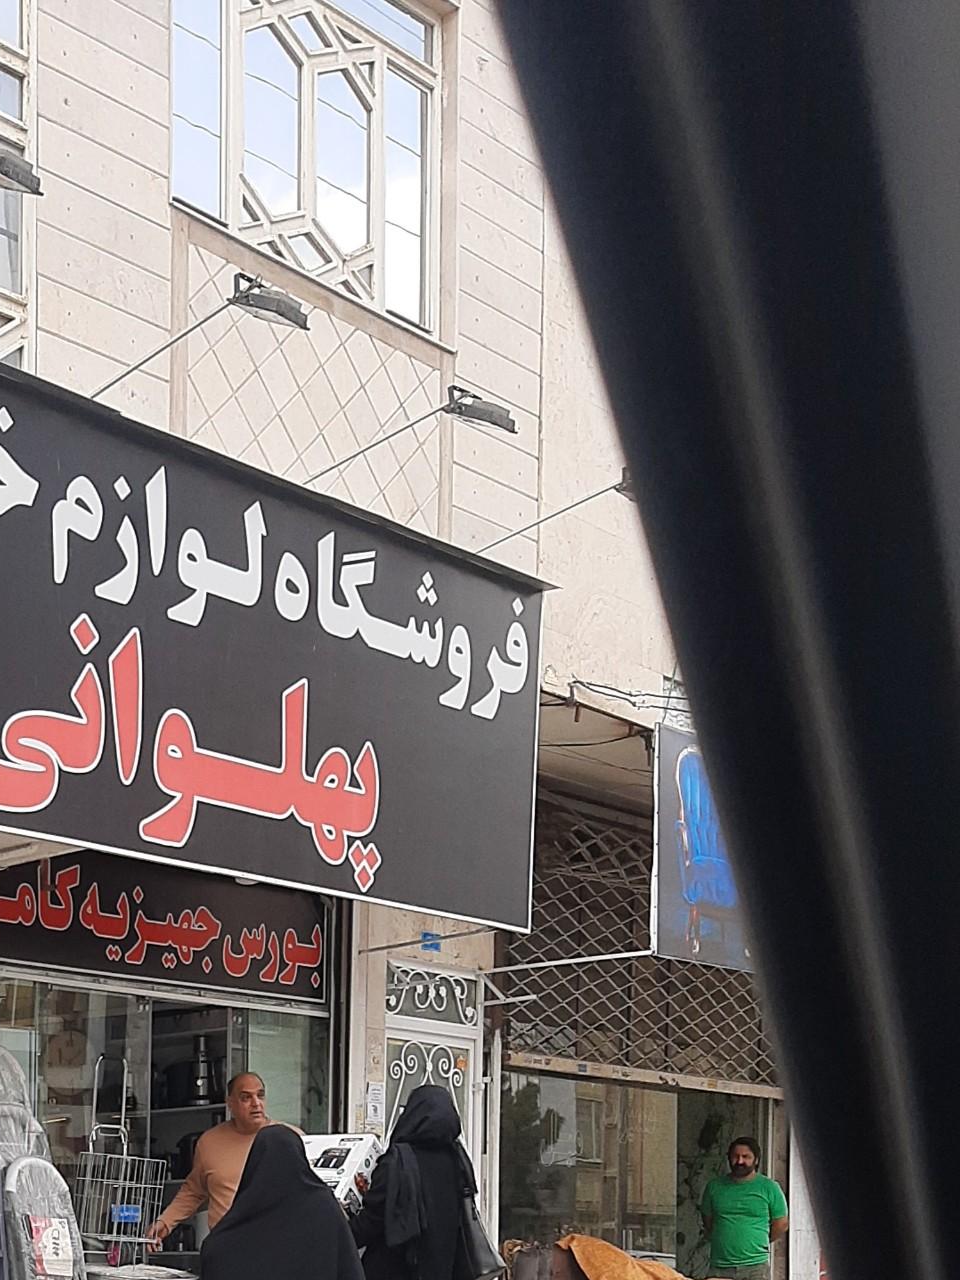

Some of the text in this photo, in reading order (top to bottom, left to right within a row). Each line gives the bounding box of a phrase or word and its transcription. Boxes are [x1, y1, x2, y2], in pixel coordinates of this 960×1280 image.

[50, 464, 268, 628] لوازم
[273, 530, 530, 721] فروشگاه
[78, 885, 222, 974] جهیزیه
[222, 922, 323, 988] بورس
